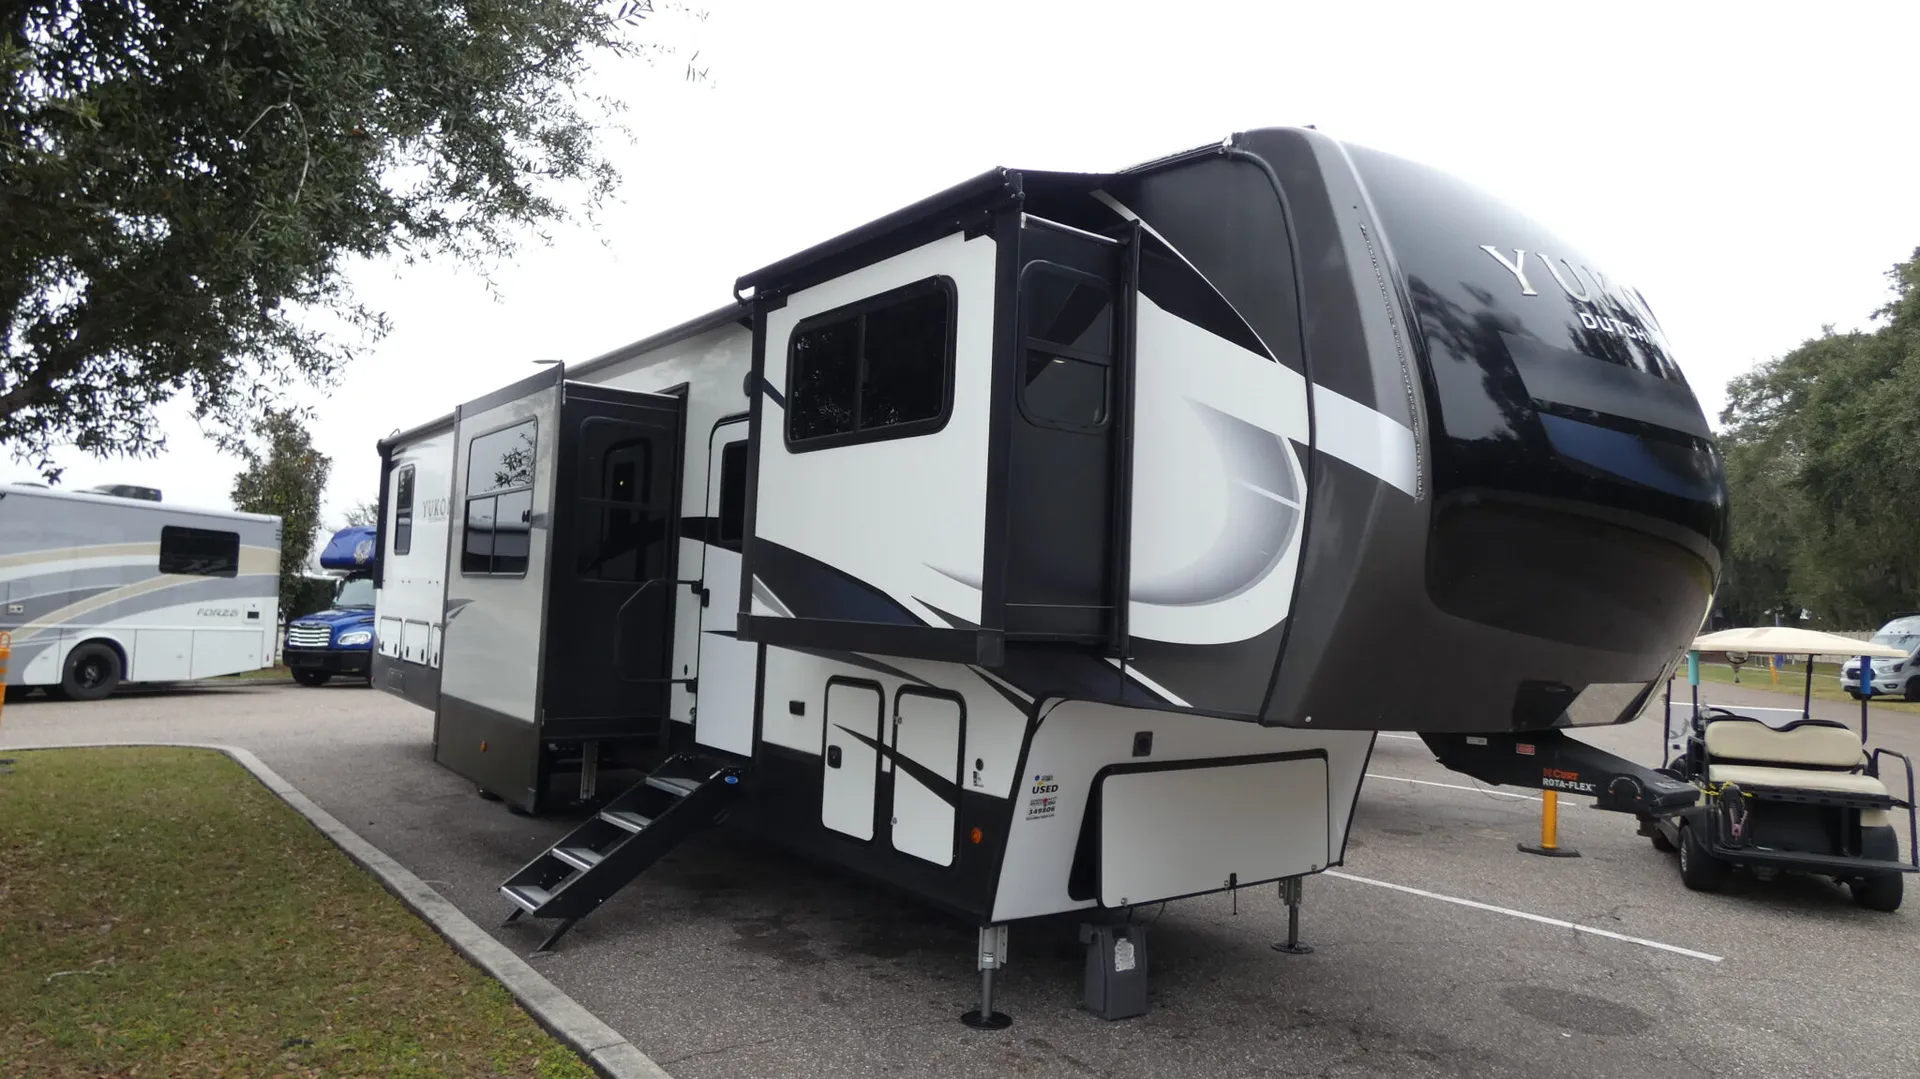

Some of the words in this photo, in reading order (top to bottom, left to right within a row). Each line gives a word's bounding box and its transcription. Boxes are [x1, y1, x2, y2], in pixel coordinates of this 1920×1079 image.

[1479, 244, 1668, 341] YUKO
[422, 498, 449, 518] YUKO
[1032, 784, 1059, 795] USED
